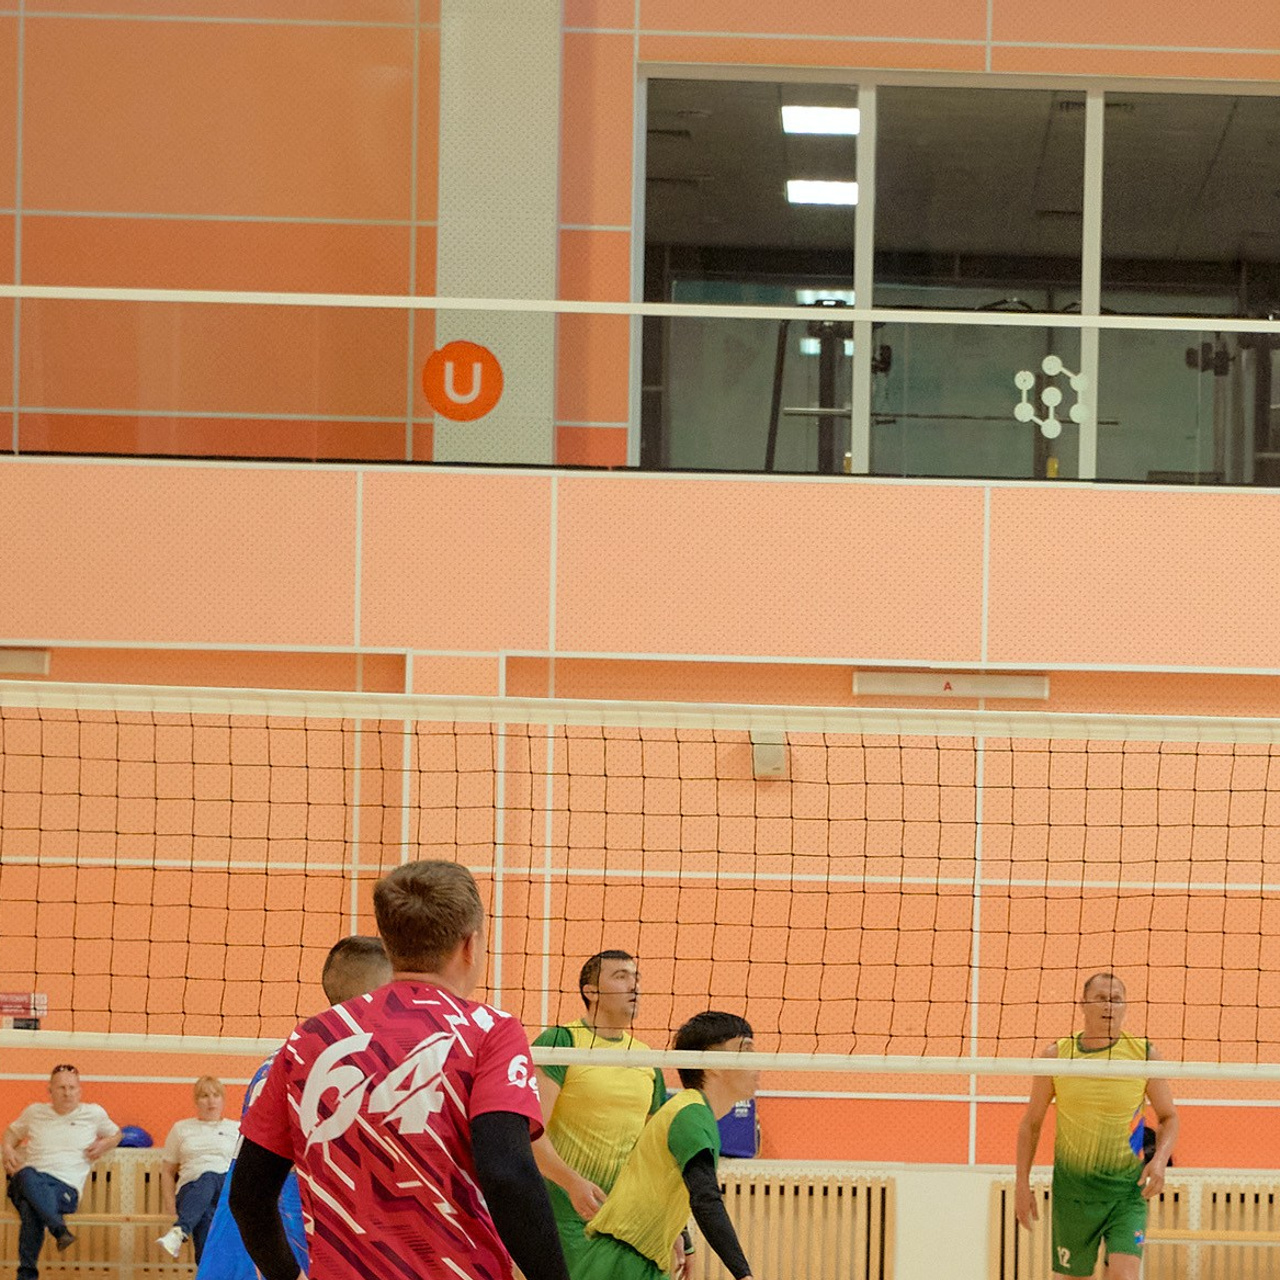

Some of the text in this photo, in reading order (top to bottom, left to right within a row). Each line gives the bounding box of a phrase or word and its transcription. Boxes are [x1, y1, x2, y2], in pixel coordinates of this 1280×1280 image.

[444, 361, 482, 404] U
[300, 1031, 457, 1157] 64
[1057, 1246, 1071, 1268] 12
